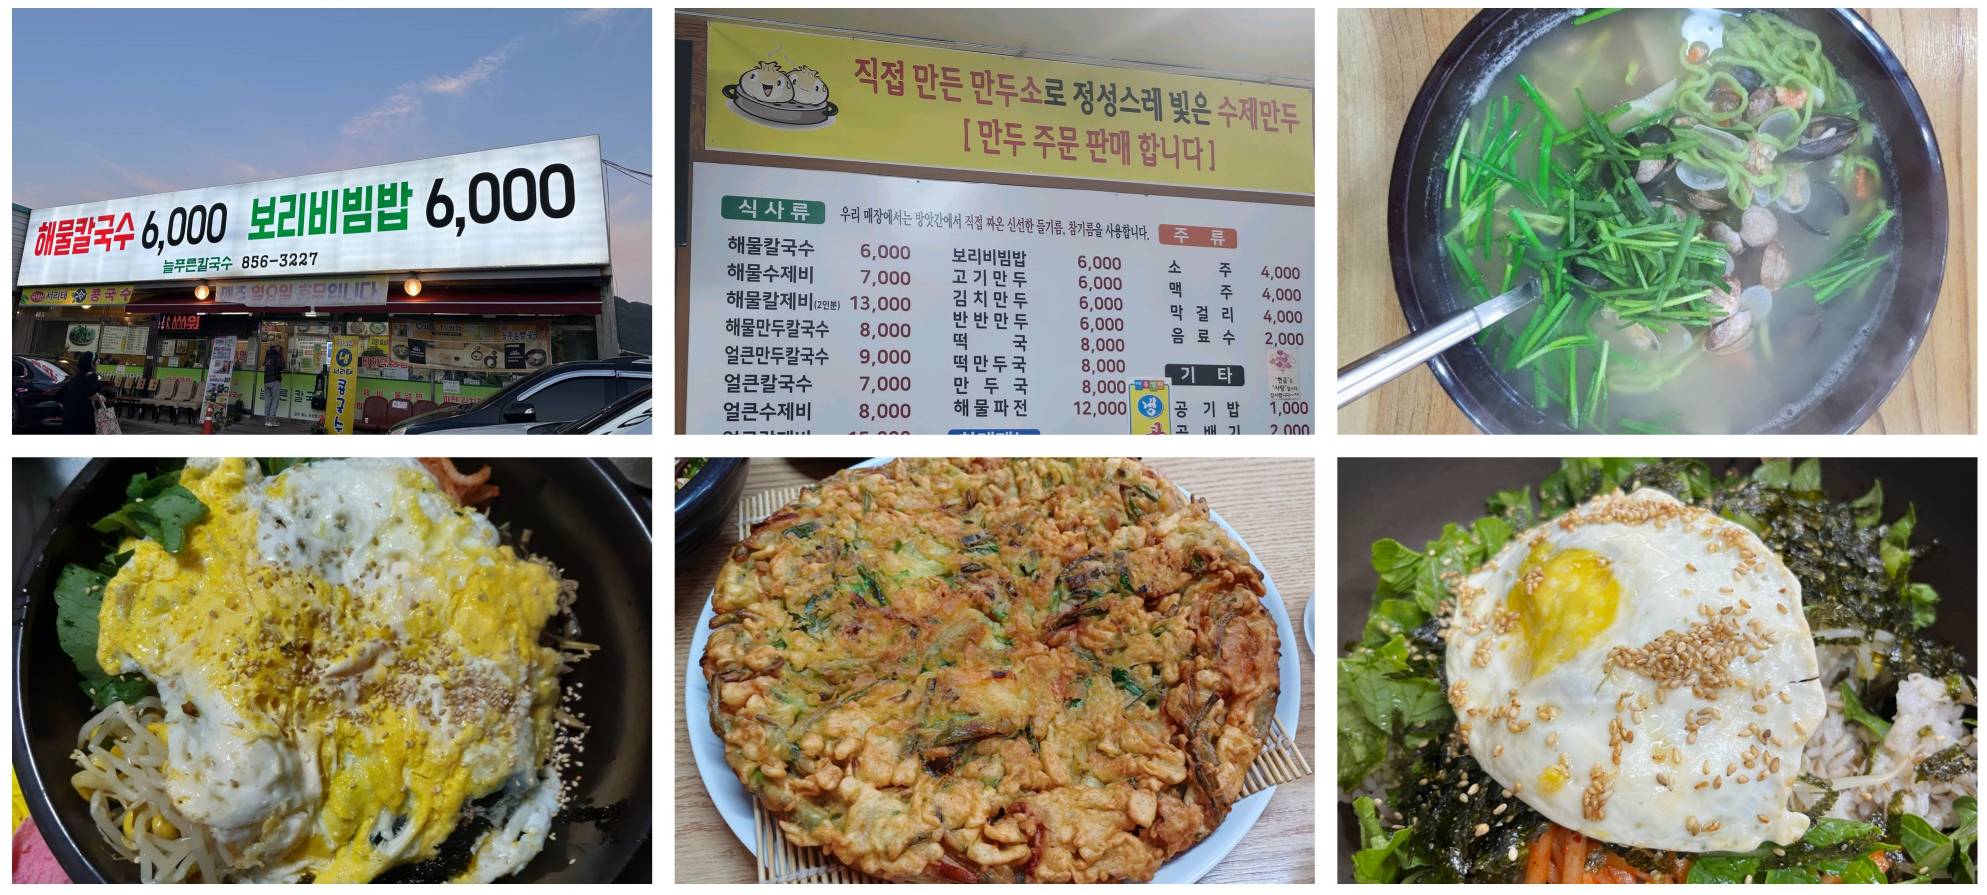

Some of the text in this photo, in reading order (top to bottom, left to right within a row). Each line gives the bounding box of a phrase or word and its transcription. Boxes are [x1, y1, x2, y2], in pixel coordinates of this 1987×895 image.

[854, 57, 905, 97] 직접
[913, 63, 964, 103] 만든
[970, 70, 1067, 107] 만두소로
[1073, 79, 1163, 122] 정성스레
[1217, 96, 1301, 134] 수제만두
[979, 119, 1026, 157] 만두
[1033, 125, 1079, 161] 주문
[1085, 129, 1131, 166] 판매
[34, 162, 576, 257] 해물칼국수 6,000 보리비빔밥 6,000
[738, 199, 811, 220] 식사류
[840, 205, 860, 223] 우리
[863, 207, 913, 227] 매장에서는
[914, 210, 962, 230] 방앗간에서
[964, 213, 983, 231] 직접
[985, 215, 1004, 232] 짜온
[1006, 216, 1035, 234] 신선한
[1068, 220, 1103, 238] 참기름을
[1105, 222, 1150, 241] 사용합니다.
[727, 235, 911, 262] 해물칼국수 6,000
[162, 251, 319, 275] 늘푸른칼국수 856-3227
[952, 248, 1122, 272] 보리비빔밥 6,000
[726, 262, 911, 289] 해물수제비 7,000
[1260, 265, 1301, 281] 4,000
[251, 284, 293, 299] 일요일
[1078, 275, 1123, 292] 6,000
[1079, 296, 1123, 313] 6,000
[1262, 287, 1302, 303] 4,000
[849, 296, 911, 315] 13,000
[1080, 317, 1124, 333] 6,000
[1263, 309, 1303, 326] 4,000
[725, 318, 911, 341] 해물만두칼국수 8,000
[1080, 338, 1125, 355] 8,000
[1264, 331, 1304, 348] 2,000
[724, 345, 911, 368] 얼큰만두칼국수 9,000
[1081, 359, 1126, 376] 8,000
[724, 373, 911, 395] 얼큰칼국수 7,000
[1082, 380, 1127, 397] 8,000
[723, 402, 911, 422] 얼큰수제비 8,000
[1073, 401, 1128, 418] 12,000
[1269, 401, 1310, 417] 1,000
